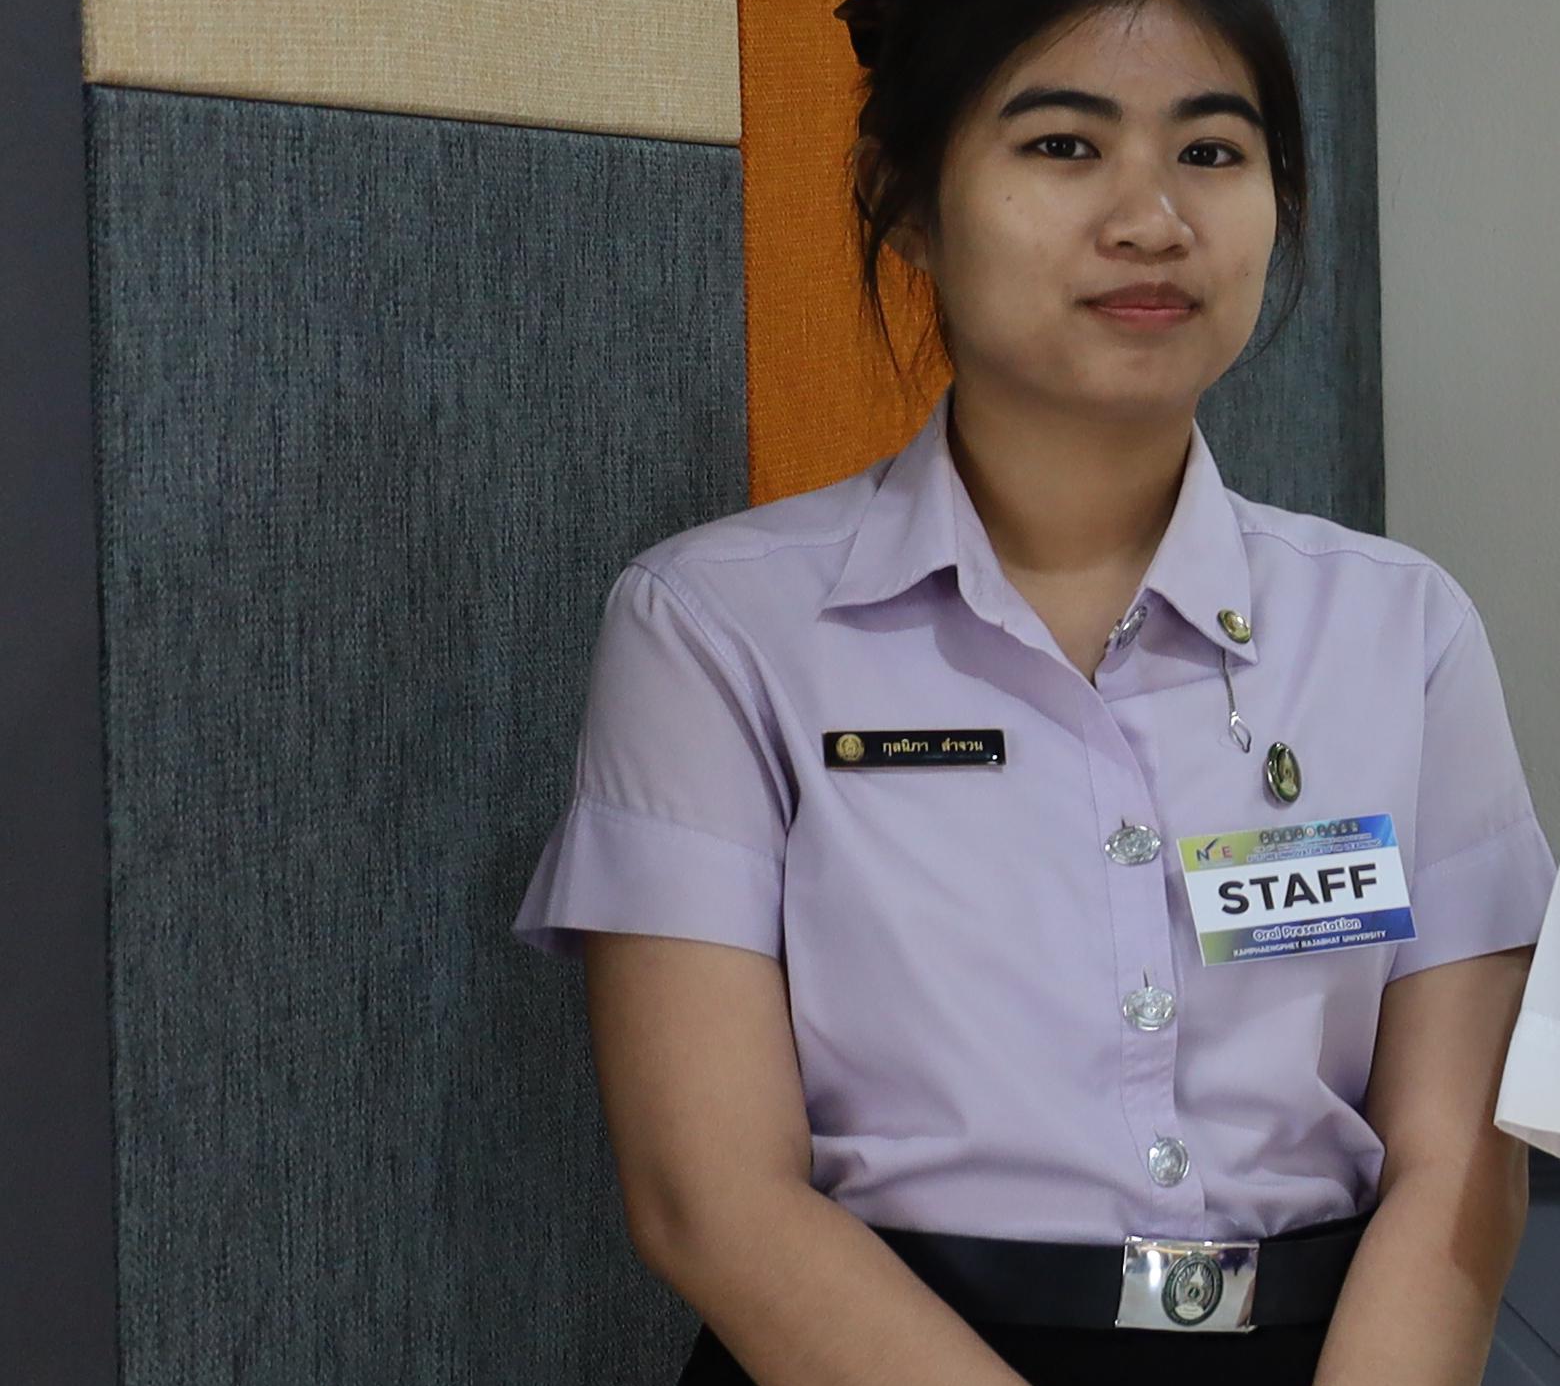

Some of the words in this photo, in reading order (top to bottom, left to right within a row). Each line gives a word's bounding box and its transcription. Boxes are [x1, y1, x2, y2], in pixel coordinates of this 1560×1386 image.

[1218, 863, 1377, 915] STAFF
[1253, 925, 1281, 942] Oral
[1283, 917, 1362, 940] Presentation
[1342, 930, 1386, 943] UNIVERSITY
